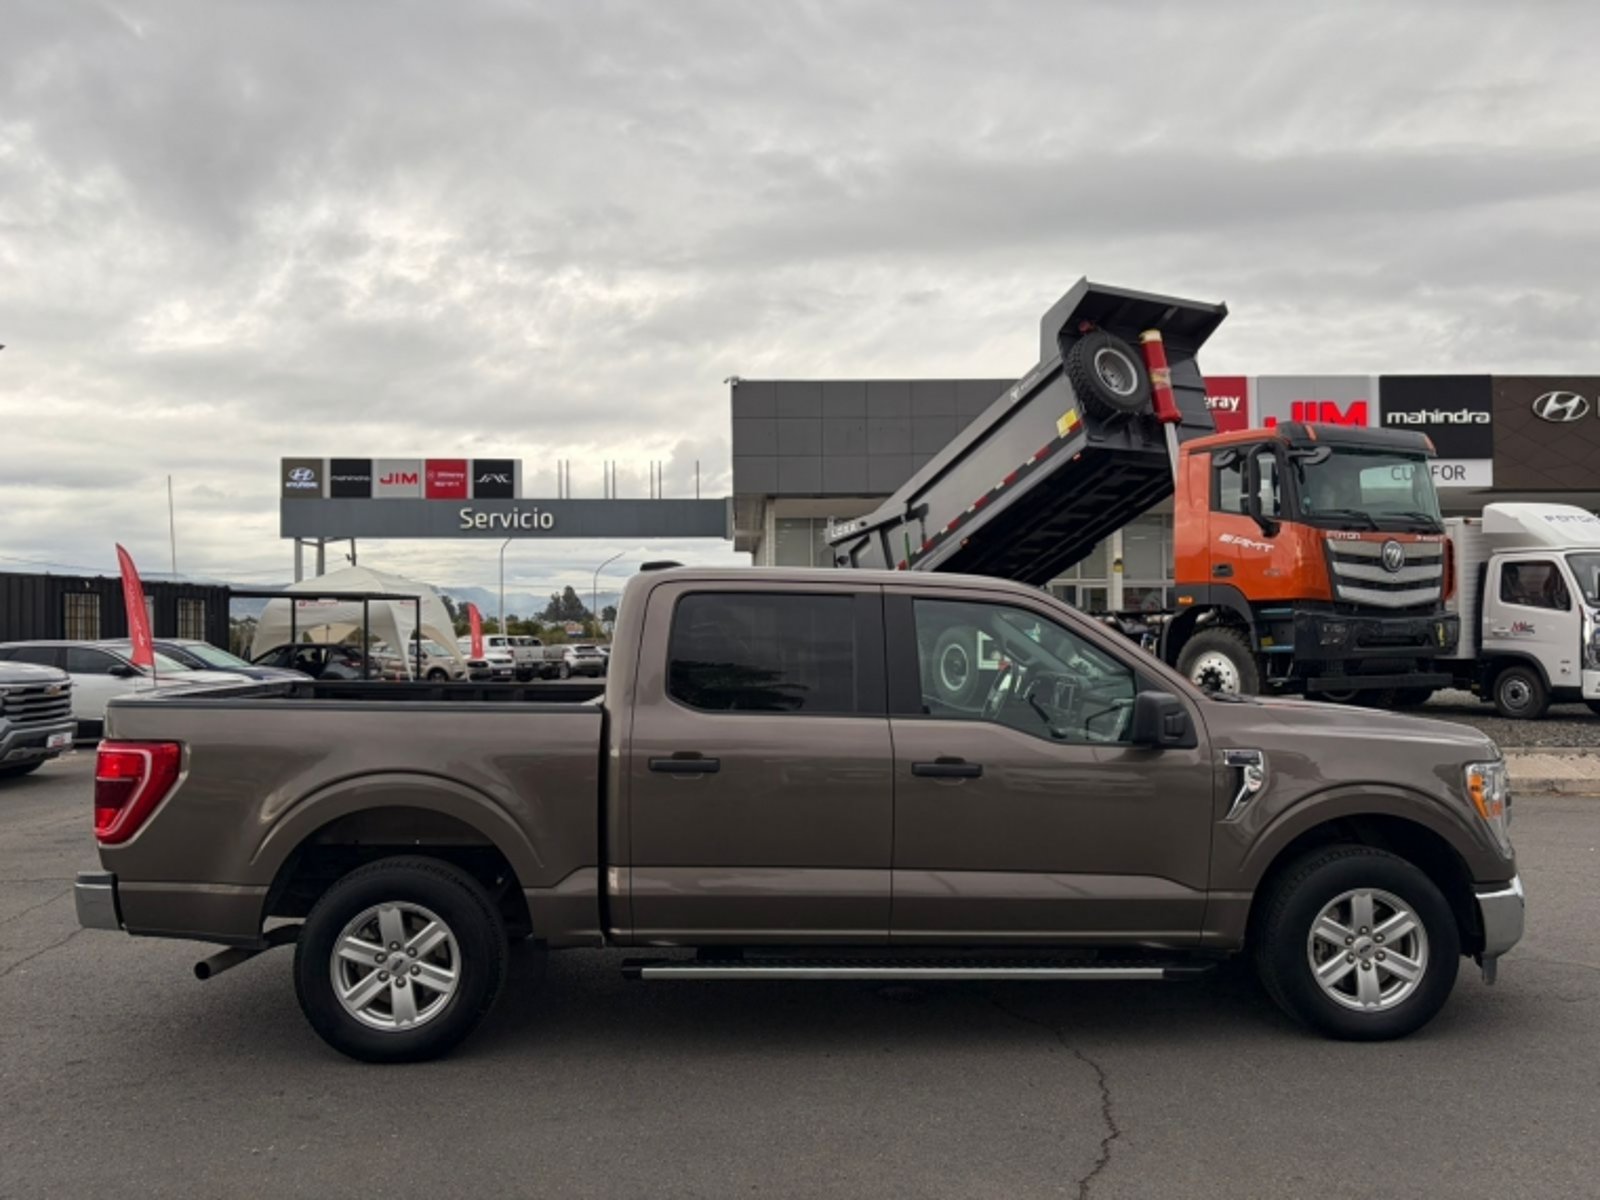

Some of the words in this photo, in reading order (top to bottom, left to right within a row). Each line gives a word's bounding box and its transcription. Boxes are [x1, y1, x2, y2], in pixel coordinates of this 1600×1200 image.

[1386, 408, 1491, 424] mahindra
[379, 472, 418, 486] JIM
[1391, 465, 1466, 481] CUFOR
[459, 507, 554, 529] Servicio
